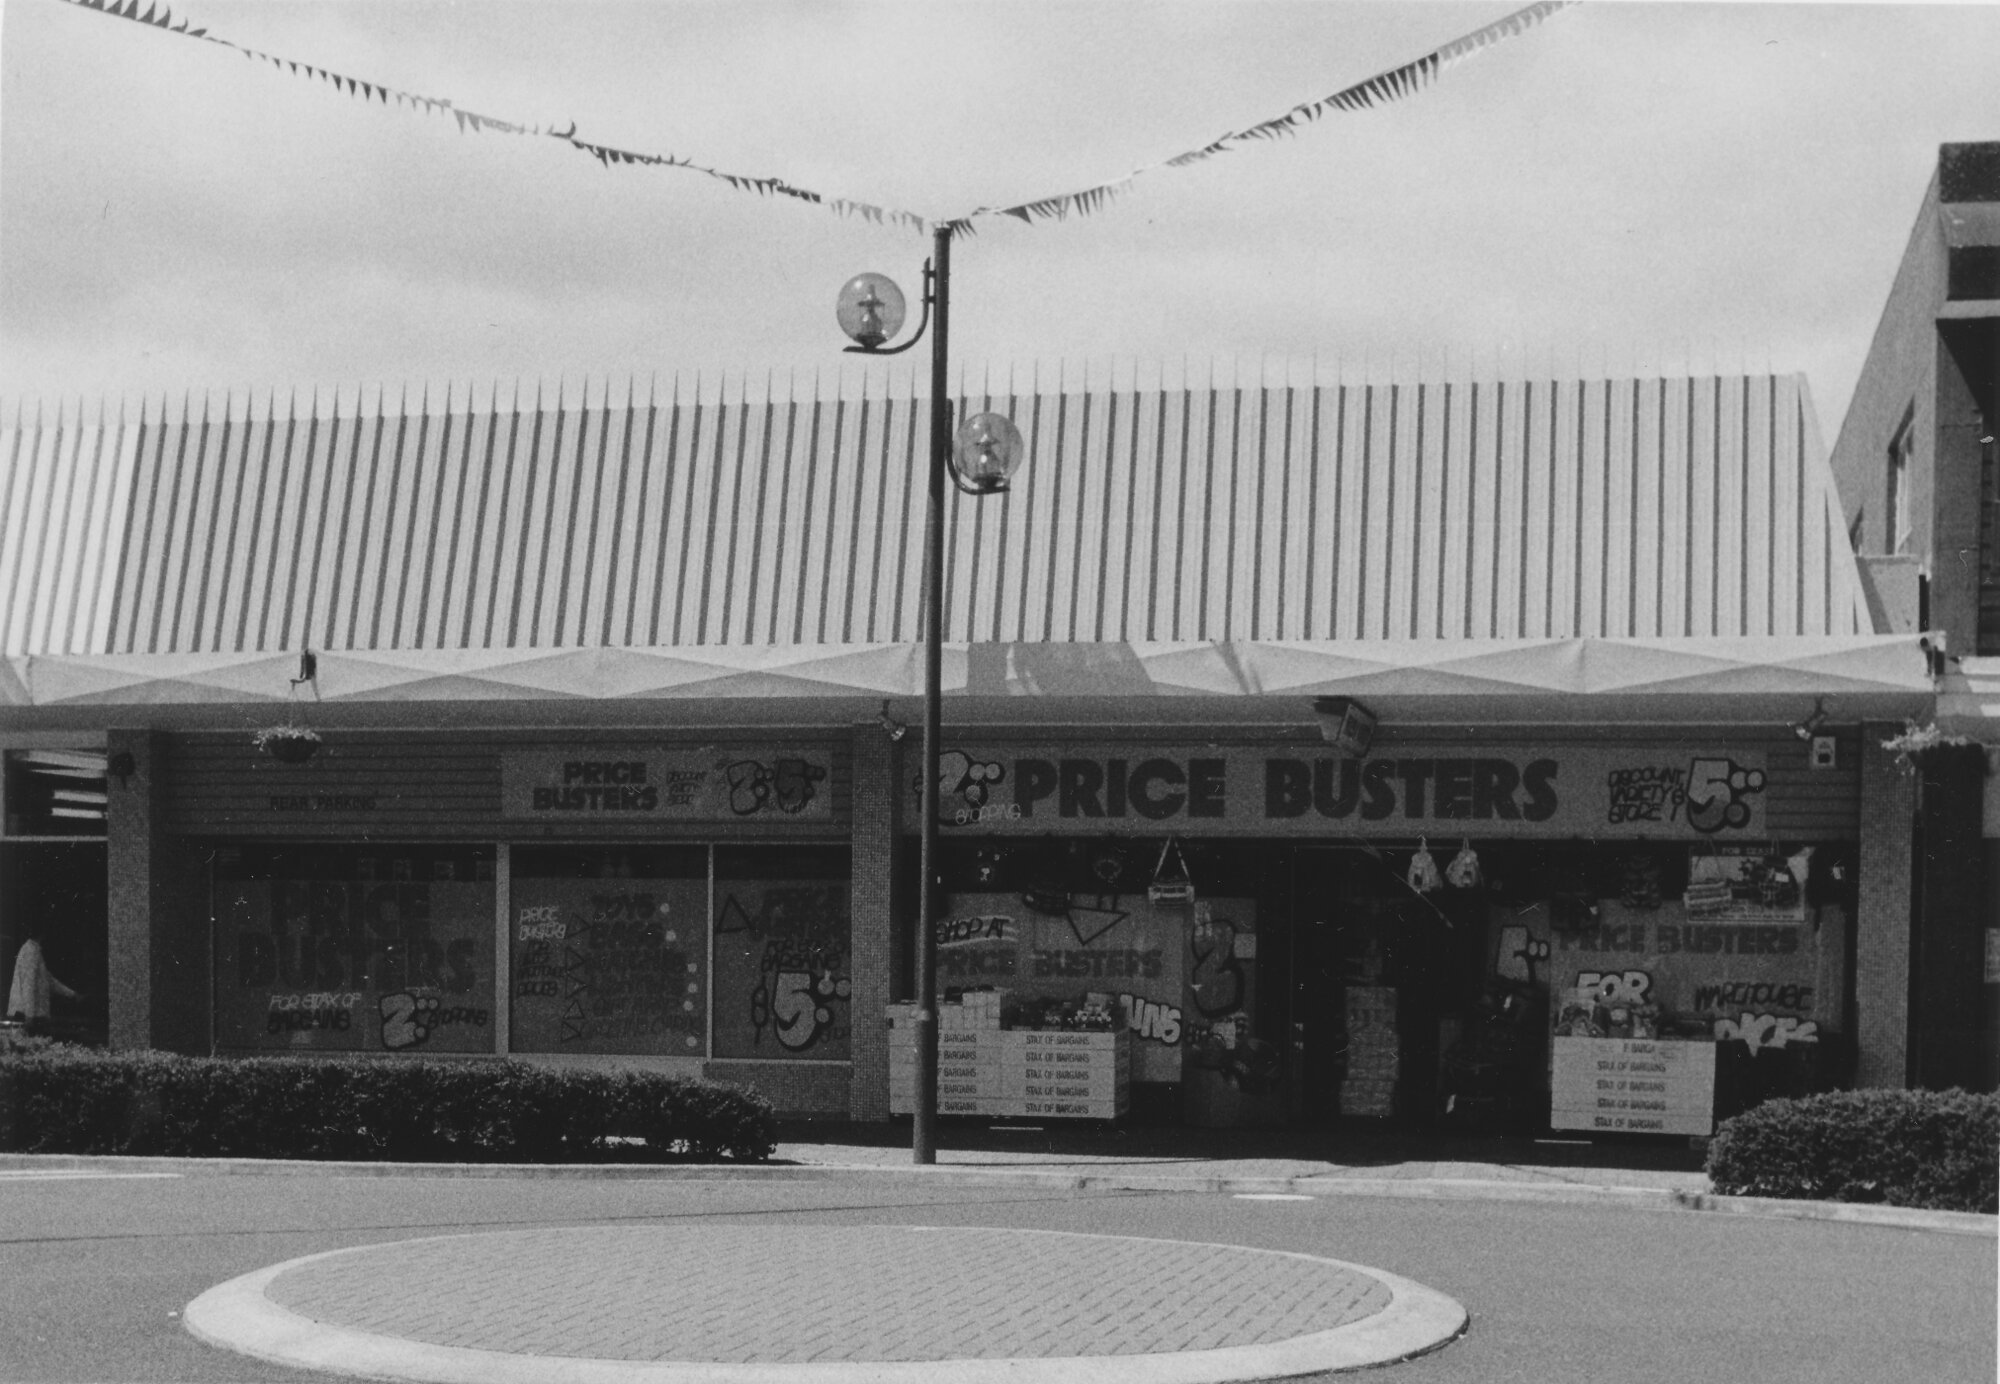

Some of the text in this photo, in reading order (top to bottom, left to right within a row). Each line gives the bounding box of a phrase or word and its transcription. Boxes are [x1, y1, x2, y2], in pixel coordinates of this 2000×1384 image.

[564, 762, 647, 784] PRICE
[1608, 767, 1686, 787] DISCOUNT
[533, 787, 659, 811] BUSTERS
[1014, 757, 1559, 822] PRICE BUSTERS
[1609, 784, 1674, 806] VARIETY
[270, 795, 376, 811] REAR PARKING
[1608, 801, 1662, 824] STORE
[271, 881, 431, 939] PRICE
[936, 918, 1010, 944] SHOP AT
[1560, 924, 1799, 955] PRICE BUSTERS
[239, 932, 476, 993] BUSTERS
[761, 953, 841, 972] BARGAINS
[1033, 949, 1162, 979] BUSTERS
[1576, 970, 1654, 1006] FOR
[268, 994, 299, 1012] FOR
[267, 1010, 351, 1035] BARGAINS
[944, 1033, 976, 1044] BARGAINS
[1045, 1035, 1054, 1044] OF
[1056, 1035, 1090, 1045] BARGAINS
[944, 1050, 976, 1061] BARGAINS
[1045, 1052, 1053, 1062] OF
[1056, 1053, 1090, 1063] BARGAINS
[944, 1067, 976, 1078] BARGAINS
[1044, 1069, 1052, 1079] OF
[1056, 1070, 1089, 1080] BARGAINS
[944, 1084, 976, 1095] BARGAINS
[1044, 1086, 1053, 1096] OF
[1056, 1087, 1089, 1097] BARGAINS
[944, 1101, 976, 1112] BARGAINS
[1044, 1103, 1054, 1113] OF
[1056, 1104, 1089, 1114] BARGAINS
